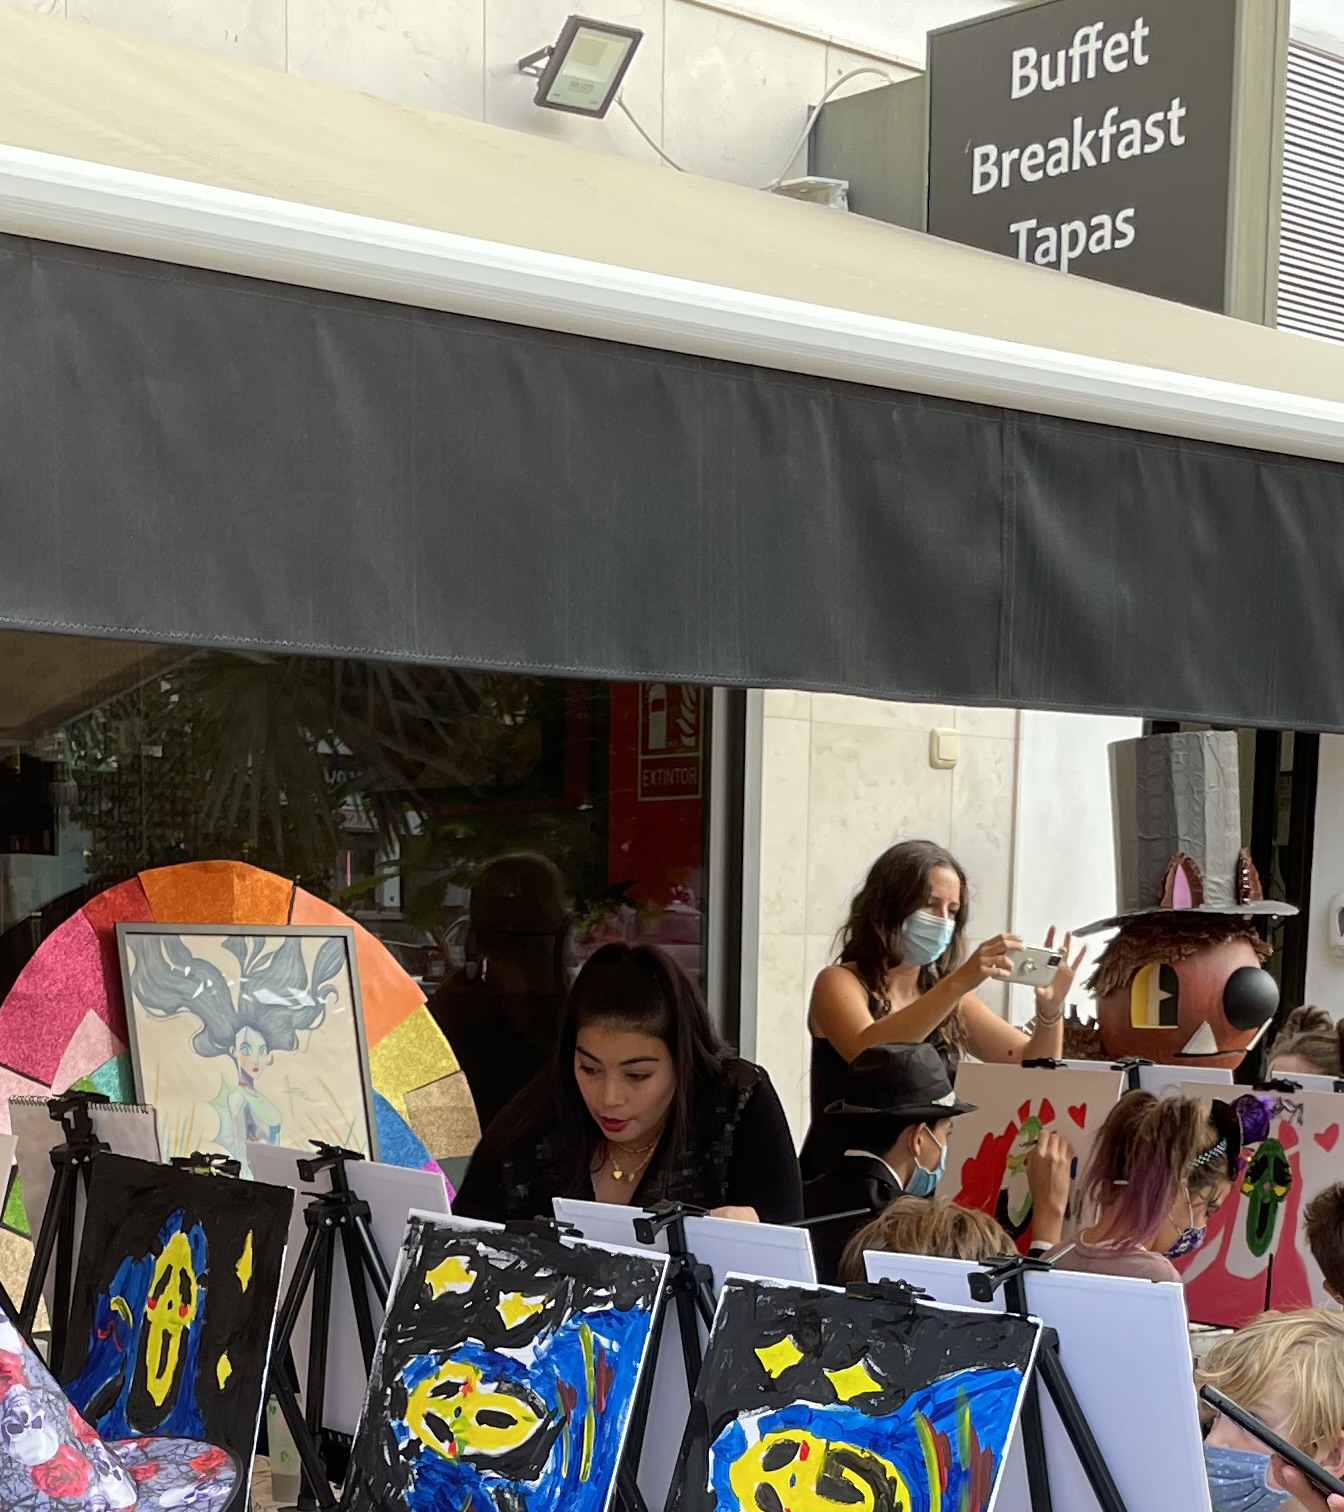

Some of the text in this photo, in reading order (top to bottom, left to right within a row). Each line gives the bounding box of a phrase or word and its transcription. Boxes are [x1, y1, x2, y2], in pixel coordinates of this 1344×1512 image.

[1010, 16, 1151, 102] Buffet
[971, 97, 1188, 197] Breakfast
[1010, 206, 1138, 274] Tapas
[642, 766, 698, 788] EXTINTOR
